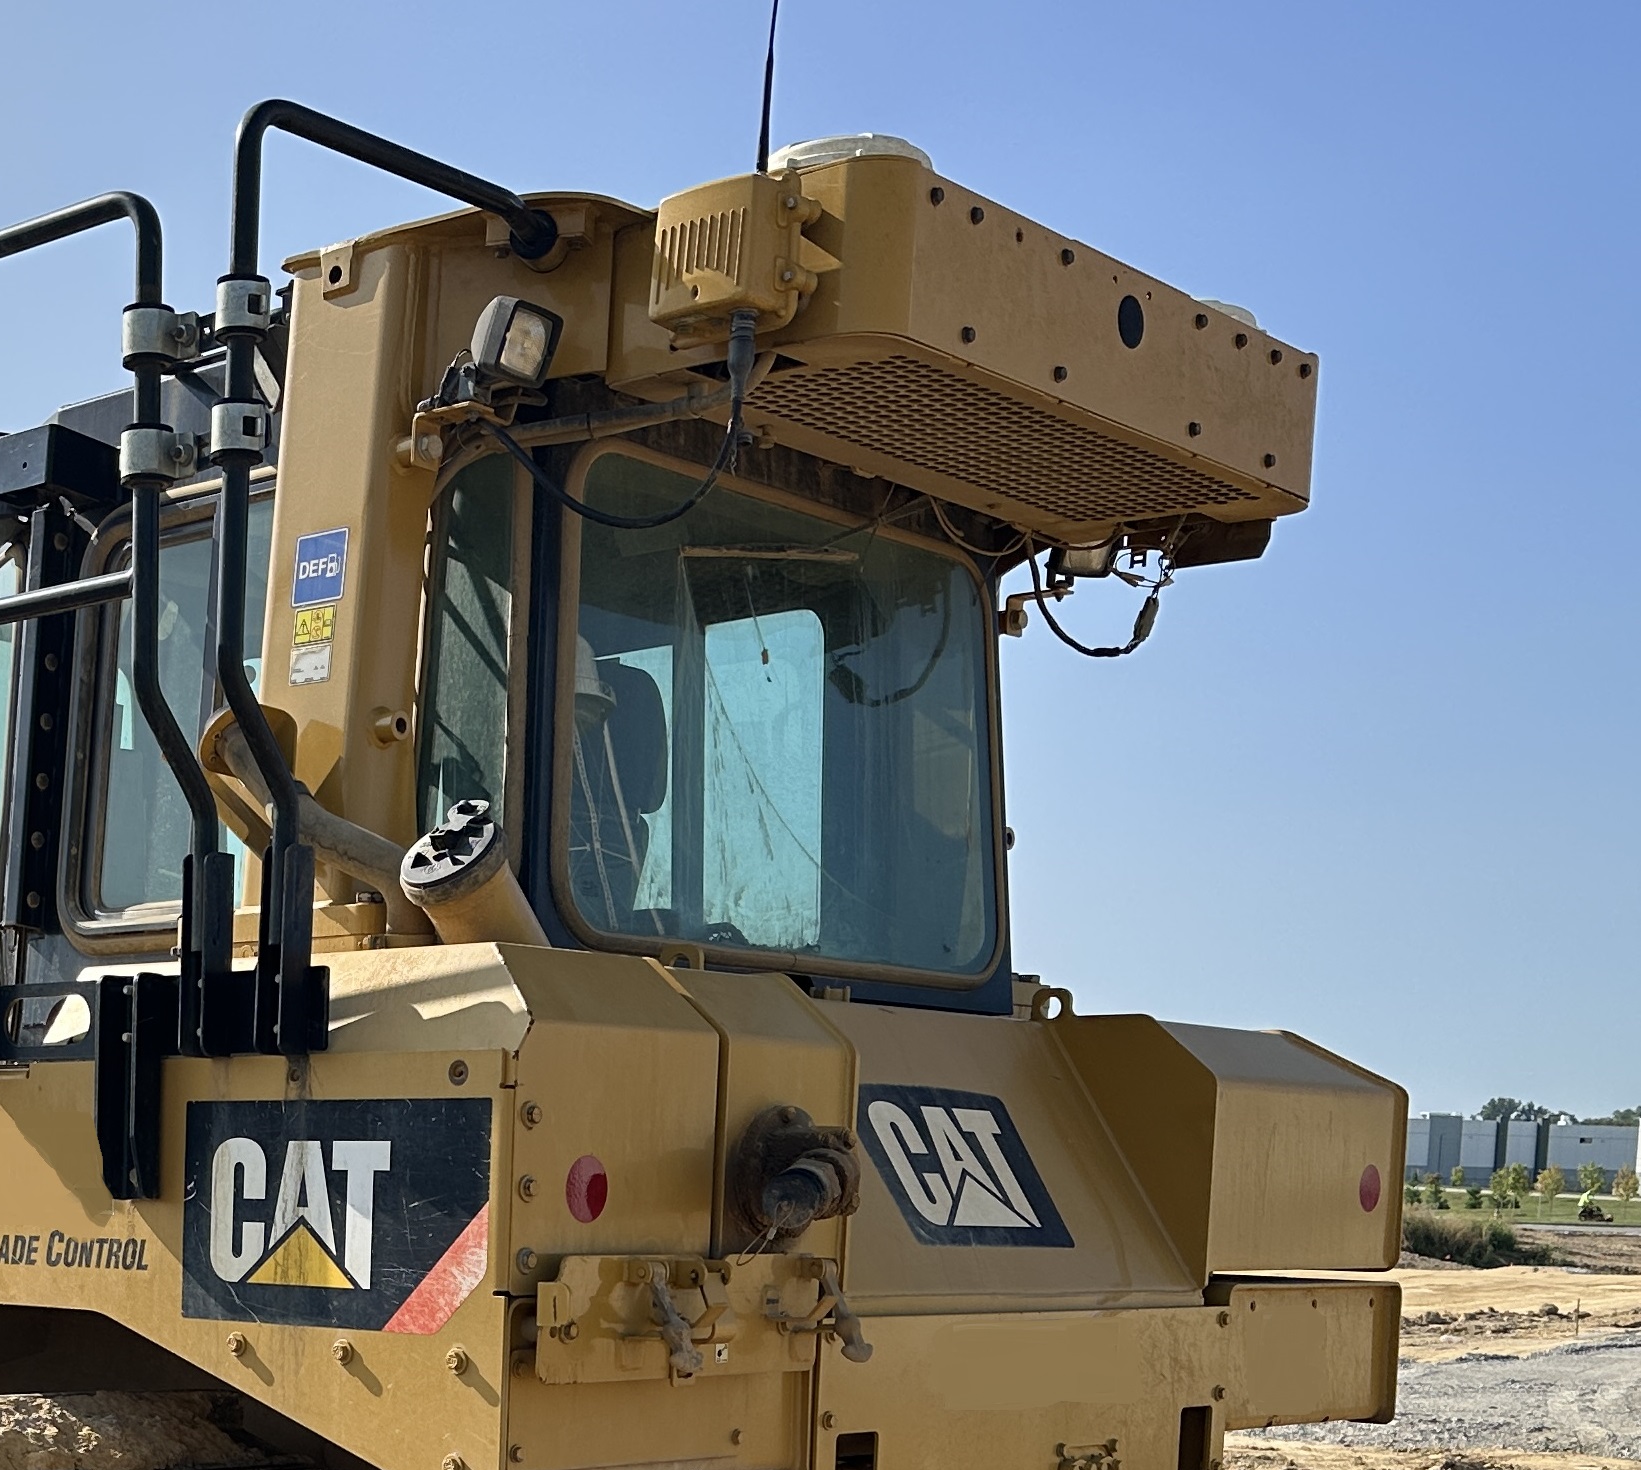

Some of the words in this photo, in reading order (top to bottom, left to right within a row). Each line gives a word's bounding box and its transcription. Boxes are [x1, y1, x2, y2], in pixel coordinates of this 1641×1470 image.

[299, 557, 328, 579] DEF
[210, 1137, 391, 1290] CAT
[868, 1100, 1043, 1228] CAT
